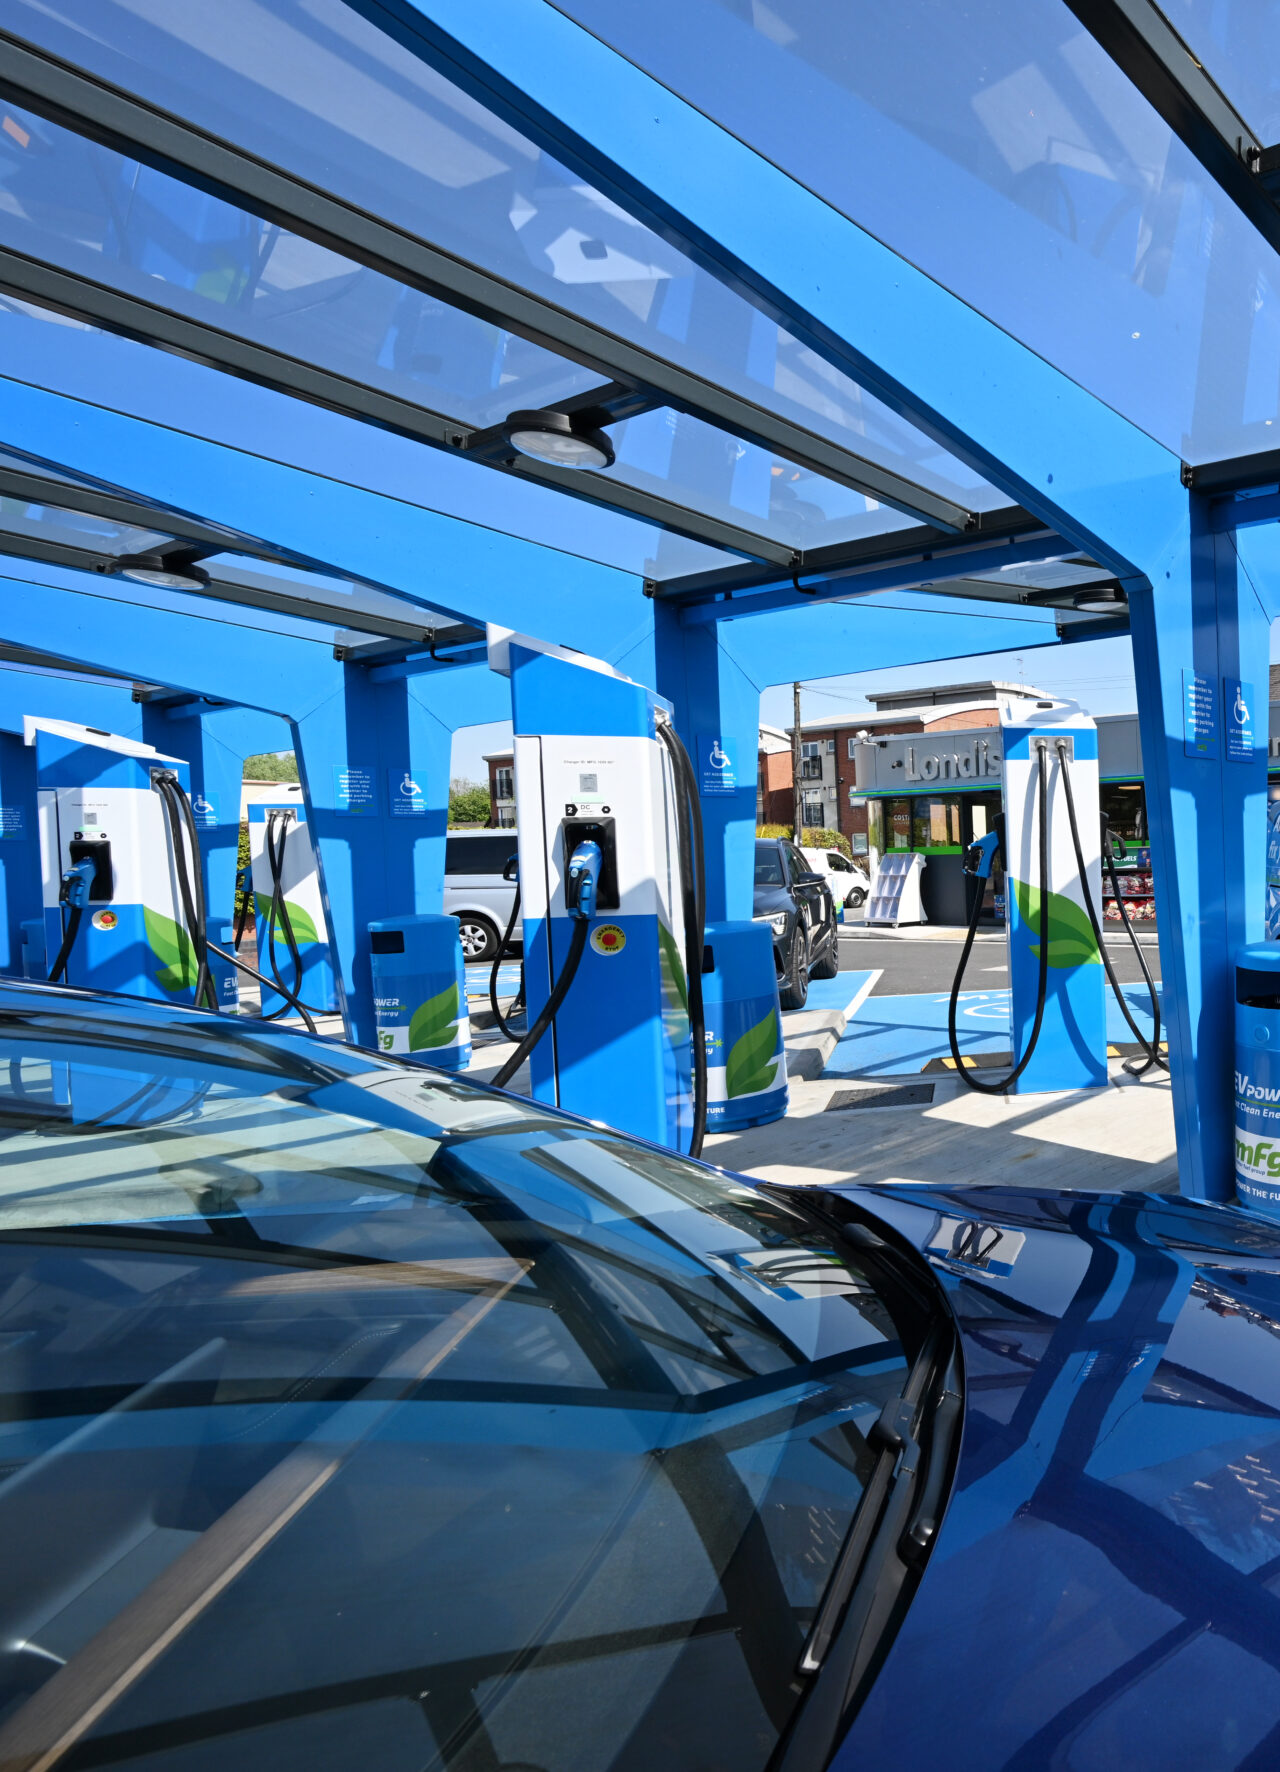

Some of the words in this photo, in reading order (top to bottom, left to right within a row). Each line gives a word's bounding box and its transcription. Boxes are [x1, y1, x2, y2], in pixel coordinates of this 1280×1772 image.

[905, 740, 1000, 781] Londis
[1241, 1102, 1261, 1116] Clean
[1236, 1179, 1250, 1194] OWER
[1252, 1188, 1267, 1199] THE
